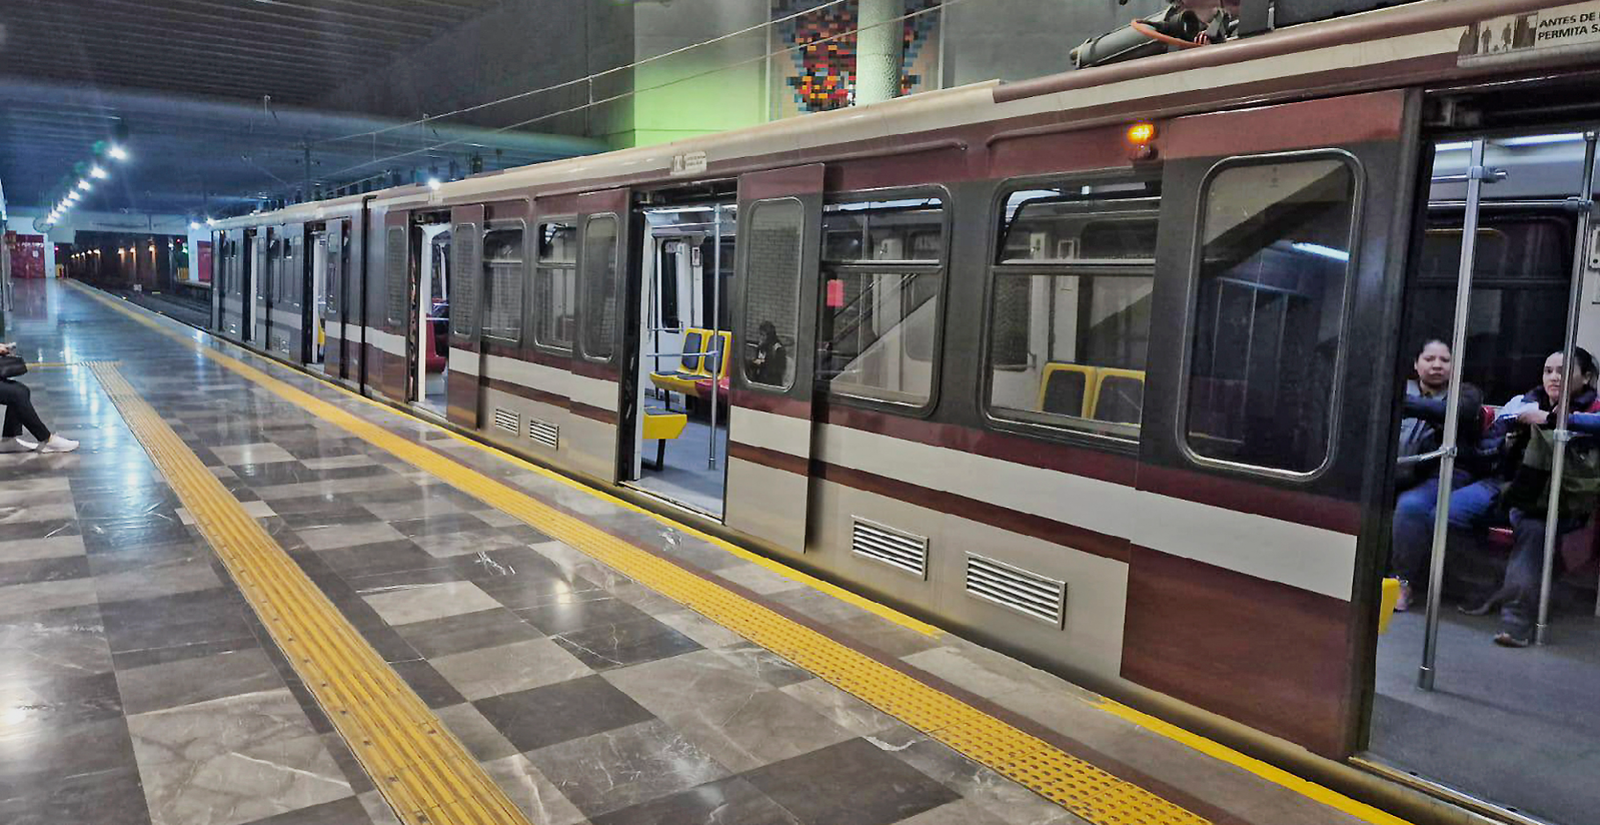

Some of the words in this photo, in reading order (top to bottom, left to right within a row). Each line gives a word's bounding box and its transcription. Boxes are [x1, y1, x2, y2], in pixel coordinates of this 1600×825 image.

[1539, 15, 1577, 28] ANTES
[1579, 11, 1596, 23] DE
[1538, 26, 1588, 41] PERMITA
[1591, 23, 1600, 33] S
